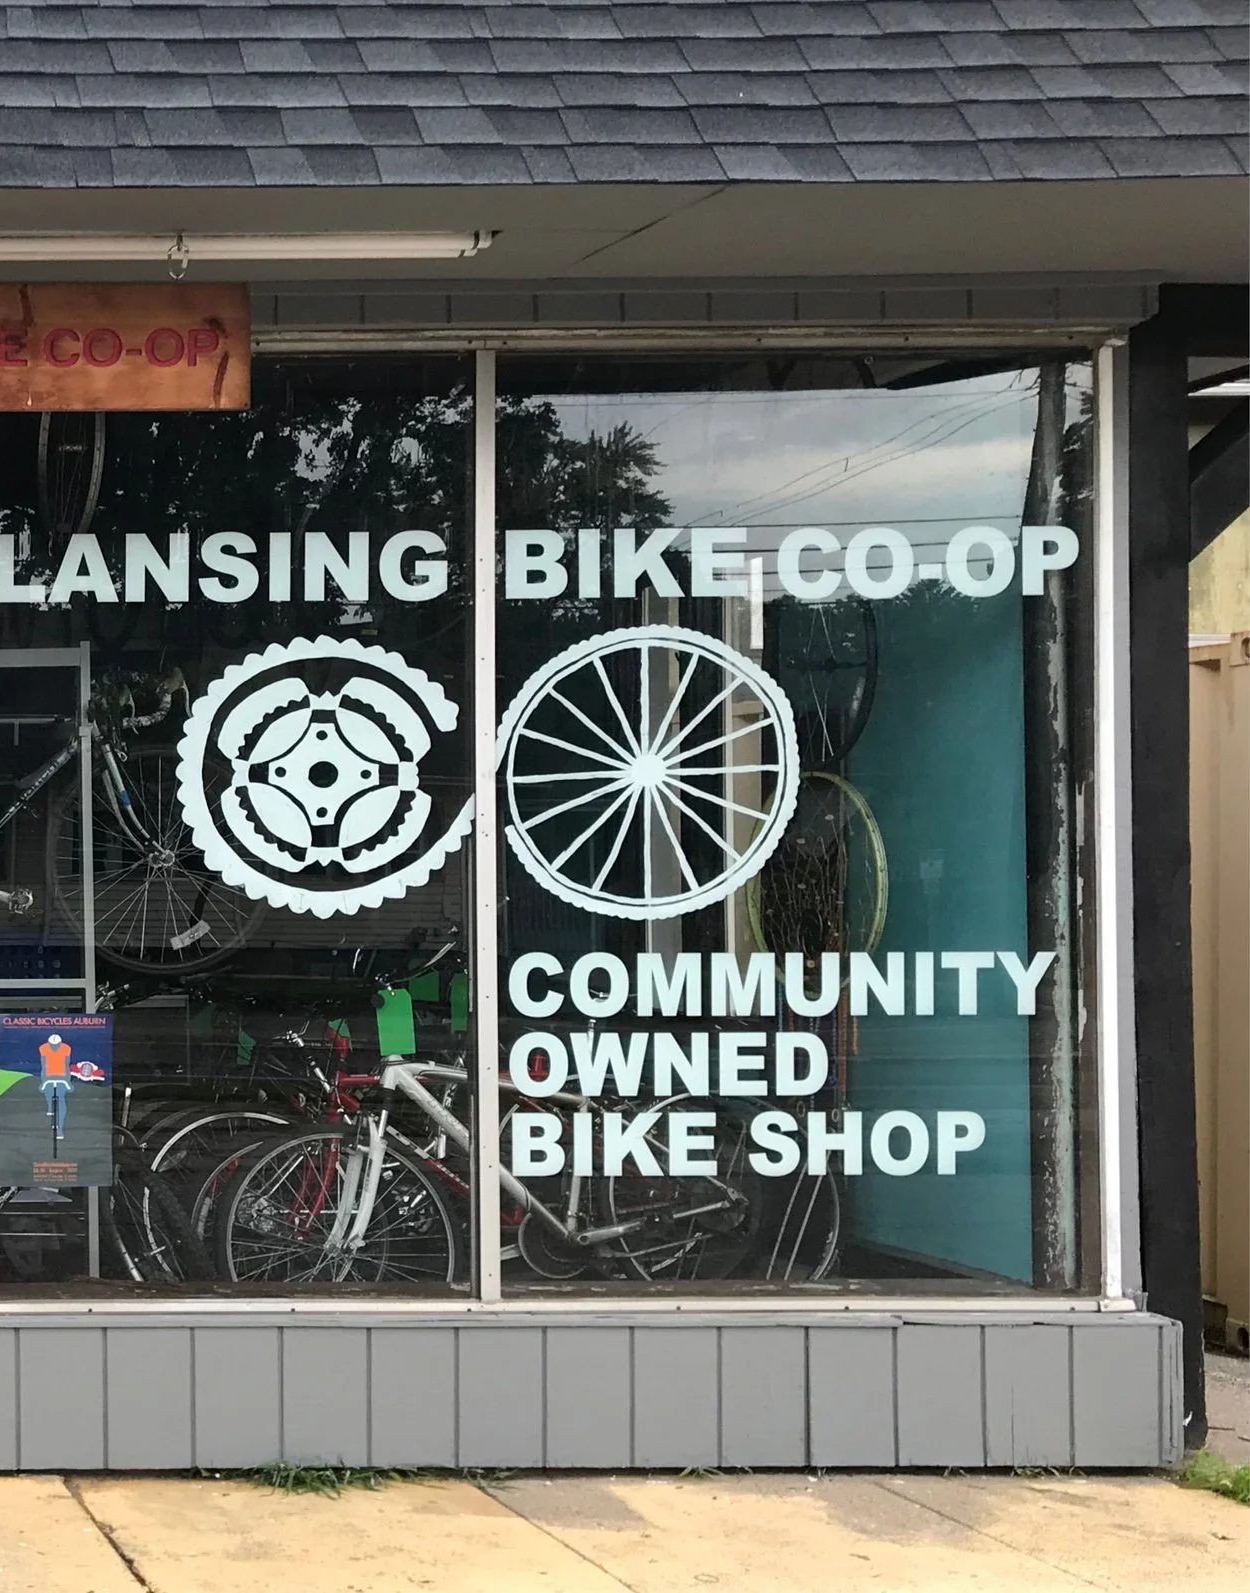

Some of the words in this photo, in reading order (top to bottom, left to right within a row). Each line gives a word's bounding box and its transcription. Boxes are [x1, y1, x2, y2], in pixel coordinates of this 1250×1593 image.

[42, 327, 220, 368] CO-OP
[504, 527, 748, 600] BIKE
[777, 525, 1080, 600] CO-OP
[508, 951, 1057, 1018] COMMUNITY
[2, 1017, 36, 1026] CLASSIC
[37, 1017, 72, 1026] BICYCLES
[73, 1017, 106, 1026] AUBURN
[508, 1032, 829, 1098] OWNED
[511, 1111, 718, 1177] BIKE
[749, 1110, 986, 1177] SHOP
